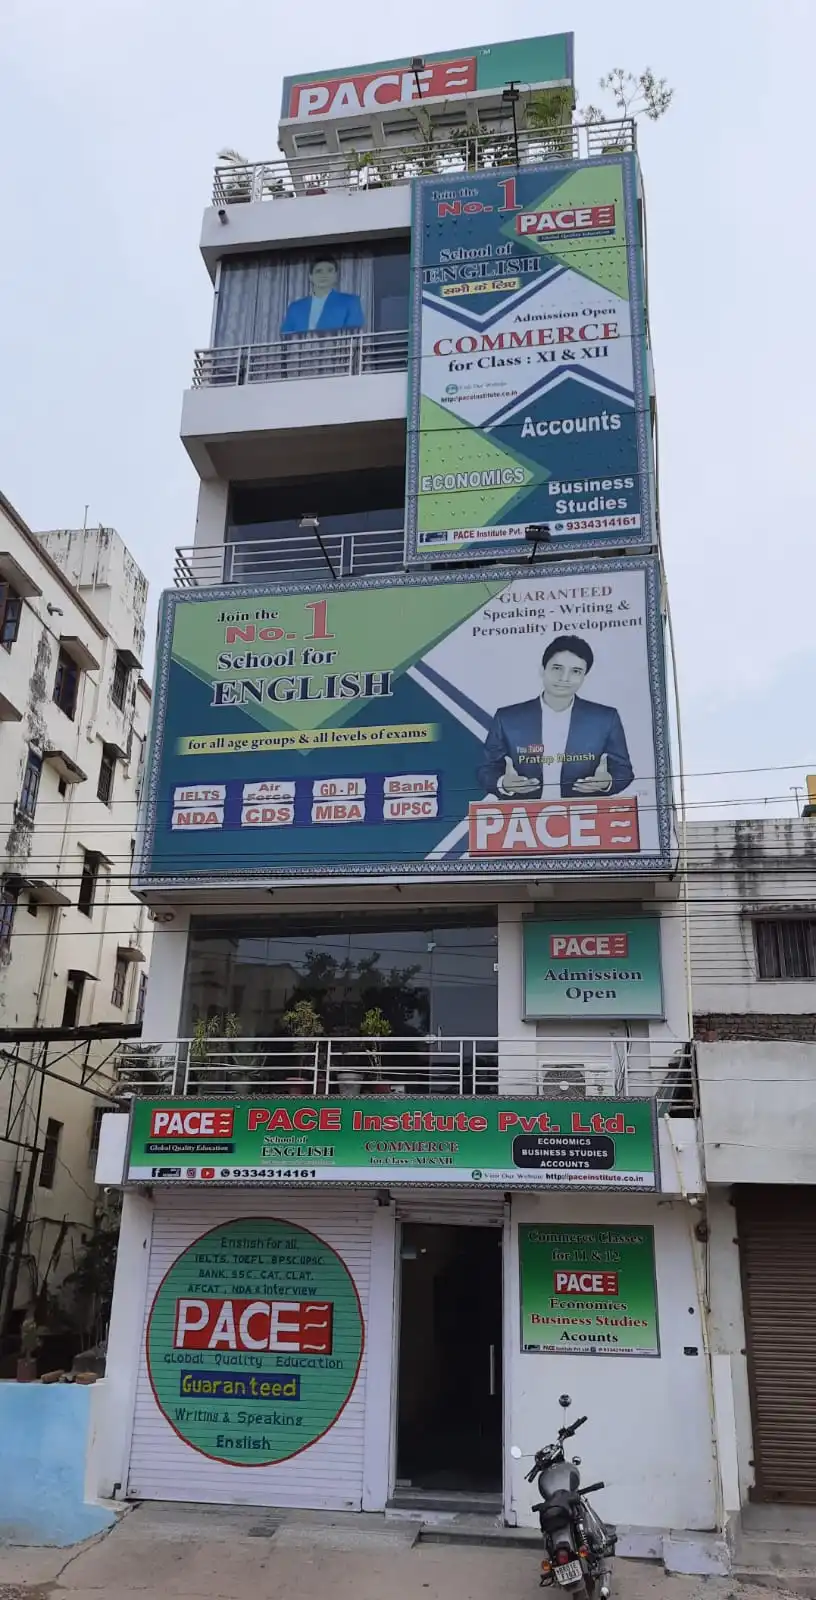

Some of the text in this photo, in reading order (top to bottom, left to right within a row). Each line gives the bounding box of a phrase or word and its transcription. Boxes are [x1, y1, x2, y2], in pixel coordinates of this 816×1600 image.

[296, 69, 433, 119] PACE
[438, 177, 523, 218] No. 1
[520, 208, 593, 233] PACE
[440, 242, 514, 262] School of
[423, 257, 541, 284] ENGLISH
[513, 307, 617, 323] Admission Open
[433, 322, 621, 356] COMMERCE
[448, 359, 473, 372] for
[477, 356, 522, 369] Class
[537, 351, 556, 363] XI
[561, 348, 576, 361] &
[581, 345, 608, 358] XII
[521, 410, 621, 438] Accounts
[421, 467, 525, 492] ECONOMICS
[548, 477, 634, 495] Business
[556, 496, 627, 514] Studies
[566, 517, 636, 531] 9334314161
[453, 529, 475, 540] PACE
[477, 529, 507, 538] Institute
[509, 527, 523, 536] Pvt.
[500, 585, 612, 603] GUARANTEED
[217, 609, 279, 623] Join the
[483, 606, 545, 622] Speaking
[559, 601, 613, 615] Writing
[617, 599, 631, 611] &
[225, 599, 335, 644] No. 1
[472, 616, 643, 636] Personality Development
[217, 647, 337, 671] School for
[210, 670, 394, 707] ENGLISH
[188, 728, 428, 751] for all age groups & all levels of exams
[258, 783, 281, 793] Air
[320, 783, 337, 797] GD
[389, 779, 435, 793] Bank
[180, 790, 220, 802] IELTS
[247, 793, 292, 802] Force
[246, 807, 291, 824] CDS
[315, 804, 362, 820] MBA
[390, 801, 432, 817] UPSC
[177, 811, 220, 826] NDA
[476, 804, 601, 850] PACE
[553, 936, 610, 956] PACE
[544, 968, 642, 981] Admission
[566, 987, 617, 1002] Open
[154, 1111, 215, 1135] PACE
[248, 1108, 636, 1134] PACE Institute Pvt. Ltd.
[149, 1143, 229, 1152] Global Quality Education
[365, 1140, 459, 1153] COMMERCE
[537, 1137, 592, 1146] ECONOMICS
[261, 1145, 336, 1158] ENGLISH
[521, 1149, 608, 1157] BUSINESS STUDIES
[540, 1160, 590, 1169] ACCOUNTS
[233, 1168, 316, 1179] 9334314161
[267, 1238, 283, 1249] for
[529, 1231, 645, 1244] Commerce Classes
[552, 1248, 570, 1261] for
[591, 1251, 602, 1262] &
[605, 1250, 621, 1262] 12
[232, 1285, 252, 1294] NDA
[556, 1273, 604, 1293] PACE
[549, 1297, 628, 1311] Economics
[175, 1299, 301, 1351] PACE
[530, 1313, 648, 1328] Business Studies
[560, 1331, 619, 1343] Acounts
[215, 1353, 263, 1369] Quality
[276, 1356, 344, 1369] Education
[174, 1407, 303, 1427] Writing & Speaking
